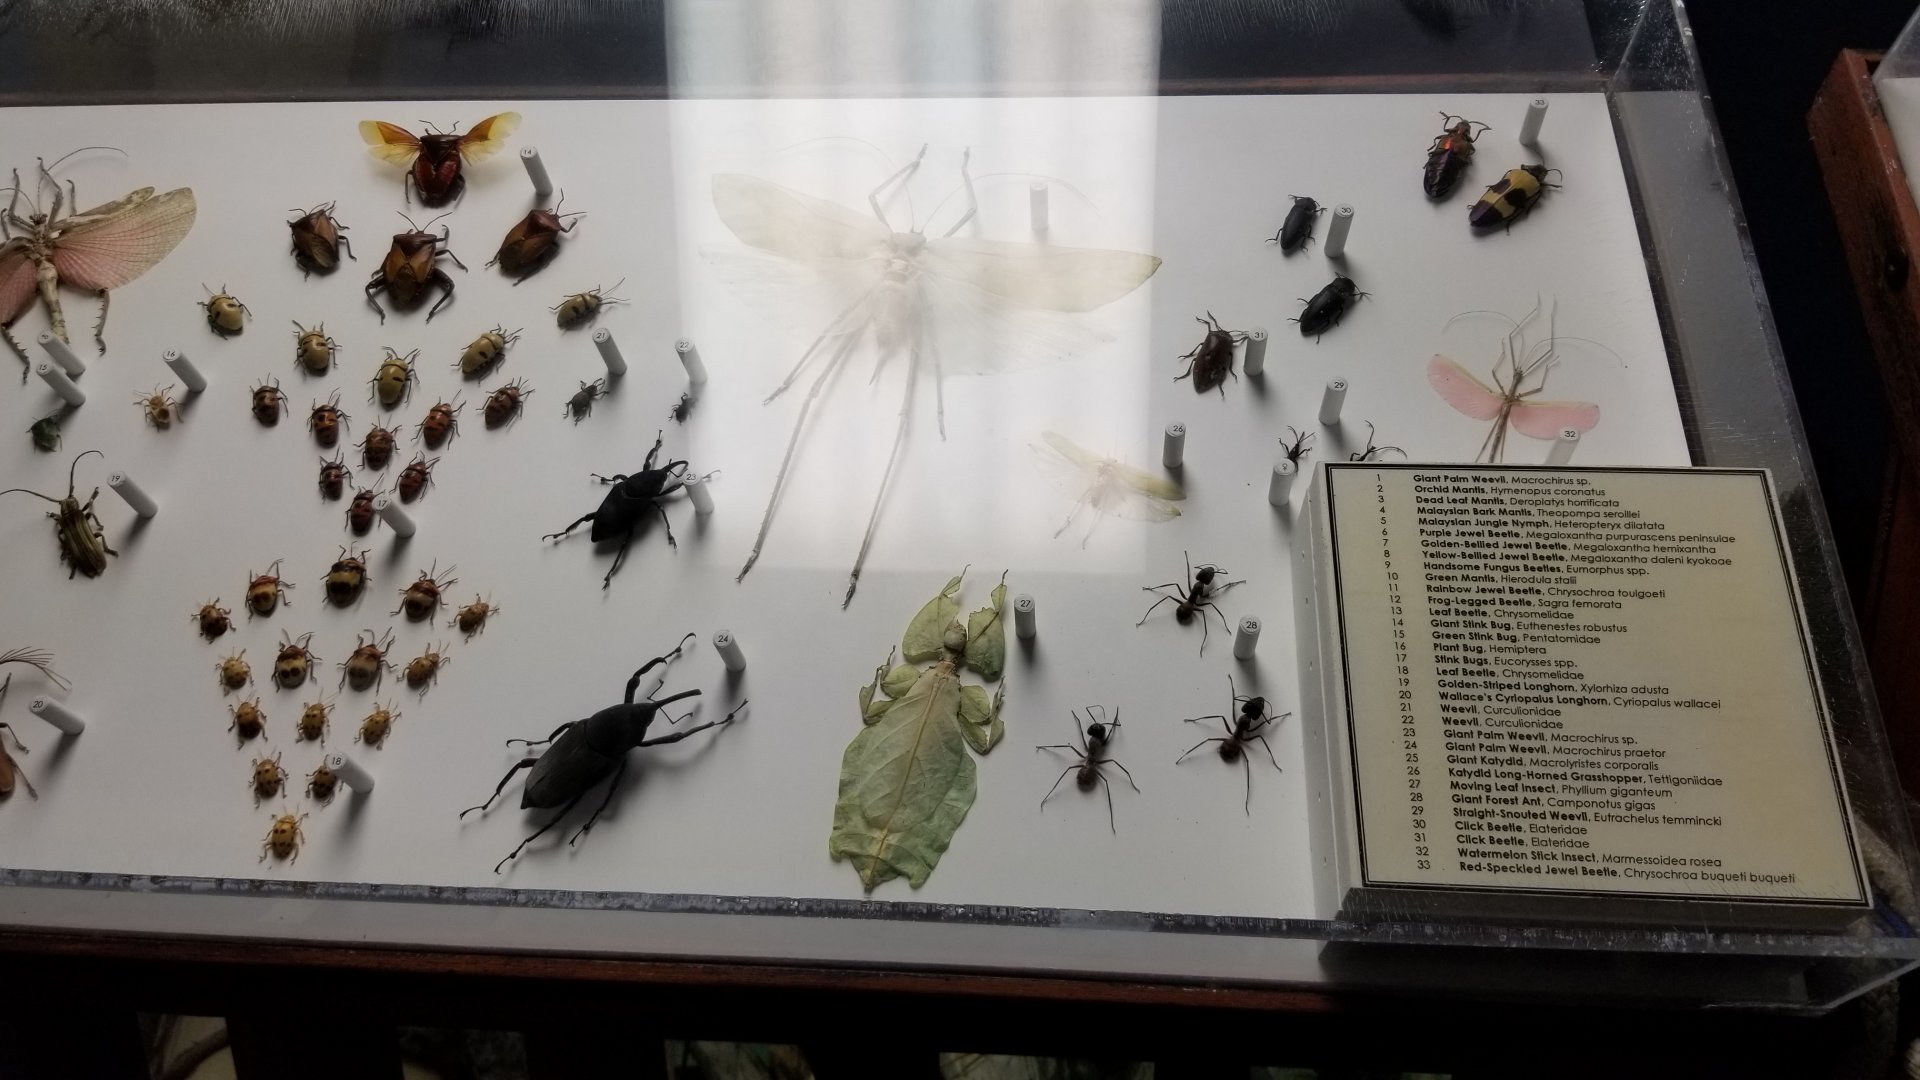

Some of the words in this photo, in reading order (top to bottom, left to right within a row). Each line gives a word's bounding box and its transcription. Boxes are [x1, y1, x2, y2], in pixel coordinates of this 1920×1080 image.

[1334, 381, 1344, 389] 29
[1376, 473, 1381, 481] 1
[1413, 474, 1441, 482] Giant
[1443, 475, 1469, 483] Palm
[1471, 475, 1508, 484] Weevil,
[1511, 477, 1574, 485] Macrochirus
[1376, 484, 1383, 492] 2
[1414, 485, 1449, 493] Orchid
[1452, 485, 1488, 495] Mantis,
[1490, 486, 1551, 496] Hymenopus
[1553, 488, 1606, 496] coronatus
[1378, 495, 1385, 503] 3
[1415, 495, 1444, 504] Dead
[1446, 496, 1468, 504] Leaf
[1471, 496, 1507, 506] Mantis,
[1509, 497, 1565, 508] Deroplatys
[1380, 516, 1387, 525] 5
[1418, 517, 1472, 528] Malaysian
[1474, 518, 1509, 528] Jungle
[1511, 518, 1552, 529] Nymph,
[1554, 519, 1621, 531] Heteropteryx
[1623, 521, 1665, 530] dilatata
[1382, 538, 1389, 547] 7
[1420, 539, 1499, 549] Golden-Bellied
[1502, 541, 1532, 550] Jewel
[1534, 541, 1571, 551] Beetle,
[1573, 543, 1650, 553] Megaloxantha
[1653, 544, 1716, 554] hemixantha
[1384, 560, 1391, 569] 9
[1423, 561, 1480, 571] Handsome
[1483, 562, 1521, 573] Fungus
[1523, 563, 1564, 573] Beetles,
[1566, 564, 1624, 575] Eumorphus
[1626, 567, 1650, 576] spp.
[1388, 583, 1398, 592] 11
[1426, 584, 1472, 593] Rainbow
[1474, 585, 1506, 594] Jewel
[1508, 586, 1545, 596] Beetle,
[1547, 587, 1615, 598] Chrysochroa
[1389, 594, 1401, 604] 12
[1427, 595, 1496, 607] Frog-Legged
[1498, 597, 1535, 607] Beetle,
[1537, 598, 1569, 609] Sagra
[1572, 599, 1622, 609] femorata
[1390, 606, 1403, 615] 13
[1428, 607, 1451, 616] Leaf
[1454, 607, 1491, 618] Beetle,
[1493, 608, 1574, 620] Chrysomelidae
[1246, 621, 1258, 629] 28
[1392, 618, 1404, 626] 14
[1430, 618, 1460, 628] Giant
[1462, 619, 1488, 629] Stink
[1490, 620, 1514, 631] Bug,
[1583, 623, 1627, 633] robustus
[1393, 629, 1405, 639] 15
[1431, 630, 1466, 640] Green
[1468, 631, 1494, 641] Stink
[1496, 632, 1520, 643] Bug,
[1522, 633, 1601, 644] Pentatomidae
[1394, 641, 1406, 651] 16
[1433, 642, 1460, 652] Plant
[1462, 643, 1486, 654] Bug,
[1489, 644, 1547, 655] Hemiptera
[1395, 653, 1407, 663] 17
[1434, 654, 1460, 664] Stink
[1462, 655, 1492, 667] Bugs,
[1554, 659, 1578, 669] spp.
[1398, 677, 1410, 687] 19
[1437, 679, 1521, 692] Golden-Striped
[1523, 681, 1578, 693] Longhorn,
[1580, 683, 1628, 694] Xylorhiza
[1630, 685, 1669, 695] adusta
[33, 700, 44, 708] 20
[1399, 702, 1411, 712] 21
[1439, 703, 1480, 714] Weevil,
[1483, 705, 1561, 717] Curculionidae
[1404, 740, 1417, 750] 24
[1445, 741, 1476, 752] Giant
[1478, 742, 1506, 753] Palm
[1508, 743, 1550, 755] Weevil,
[1552, 745, 1621, 757] Macrochirus
[1624, 748, 1666, 759] praetor
[332, 757, 341, 765] 18
[1405, 752, 1419, 763] 25
[1446, 754, 1477, 765] Giant
[1480, 755, 1526, 767] Katydid,
[1529, 757, 1601, 770] Macrolyristes
[1604, 760, 1659, 771] corporalis
[1406, 765, 1420, 776] 26
[1448, 767, 1492, 779] Katydid
[1494, 768, 1568, 781] Long-Horned
[1570, 771, 1646, 785] Grasshopper,
[1647, 774, 1723, 787] Tettigoniidae
[1408, 778, 1421, 789] 27
[1450, 780, 1492, 793] Moving
[1494, 782, 1519, 792] Leaf
[1521, 782, 1559, 794] Insect,
[1561, 784, 1607, 796] Phyllium
[1609, 786, 1673, 798] giganteum
[1409, 791, 1424, 802] 28
[1451, 793, 1482, 804] Giant
[1485, 794, 1519, 805] Forest
[1521, 796, 1544, 807] Ant,
[1547, 797, 1622, 810] Camponotus
[1624, 799, 1656, 812] gigas
[1411, 805, 1424, 815] 29
[1453, 807, 1547, 820] Straight-Snouted
[1548, 810, 1591, 823] Weevil,
[1593, 812, 1660, 824] Eutrachelus
[1662, 814, 1722, 826] temmincki
[1412, 818, 1426, 829] 30
[1454, 820, 1485, 831] Click
[1487, 821, 1526, 833] Beetle,
[1529, 823, 1588, 835] Elateridae
[1415, 845, 1429, 856] 32
[1457, 847, 1528, 860] Watermelon
[1530, 850, 1559, 861] Stick
[1560, 851, 1599, 863] Insect,
[1602, 853, 1687, 866] Marmessoidea
[1689, 858, 1722, 867] rosea
[1417, 859, 1431, 870] 33
[1459, 861, 1542, 874] Red-Speckled
[1545, 864, 1578, 876] Jewel
[1581, 865, 1621, 878] Beetle,
[1623, 867, 1698, 880] Chrysochroa
[1700, 870, 1747, 883] buqueti
[1749, 872, 1795, 885] buqueti
